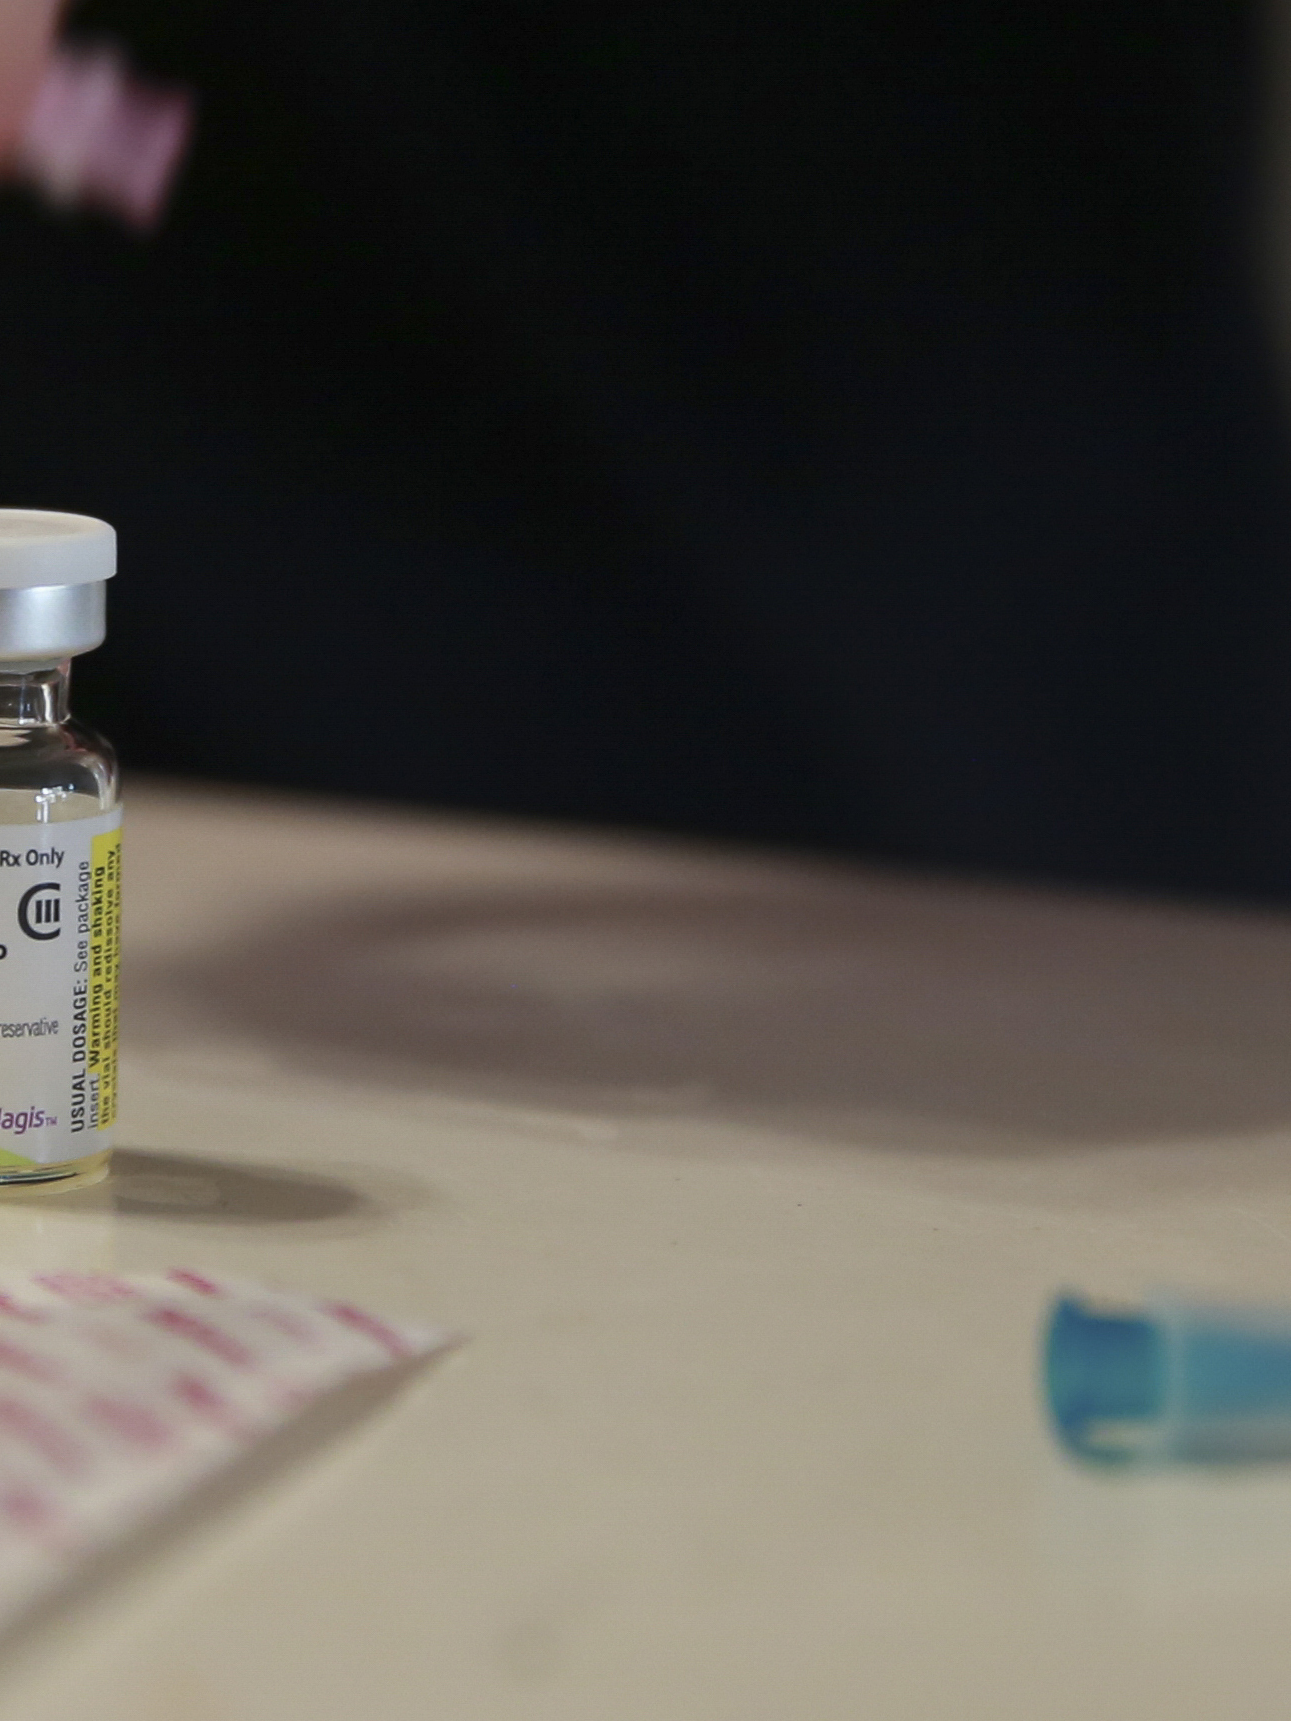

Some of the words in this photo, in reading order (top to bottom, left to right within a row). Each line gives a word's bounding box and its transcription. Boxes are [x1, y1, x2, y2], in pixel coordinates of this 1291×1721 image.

[0, 849, 21, 867] Rx
[26, 847, 65, 868] Only
[107, 850, 116, 881] any
[75, 861, 92, 934] package
[91, 866, 105, 937] shaking
[74, 940, 88, 972] See
[91, 944, 102, 976] and
[103, 889, 113, 983] redissolve
[72, 979, 87, 1063] DOSAGE:
[89, 983, 103, 1068] Warming
[102, 989, 112, 1050] should
[71, 1068, 86, 1133] USUAL
[101, 1056, 110, 1090] vial
